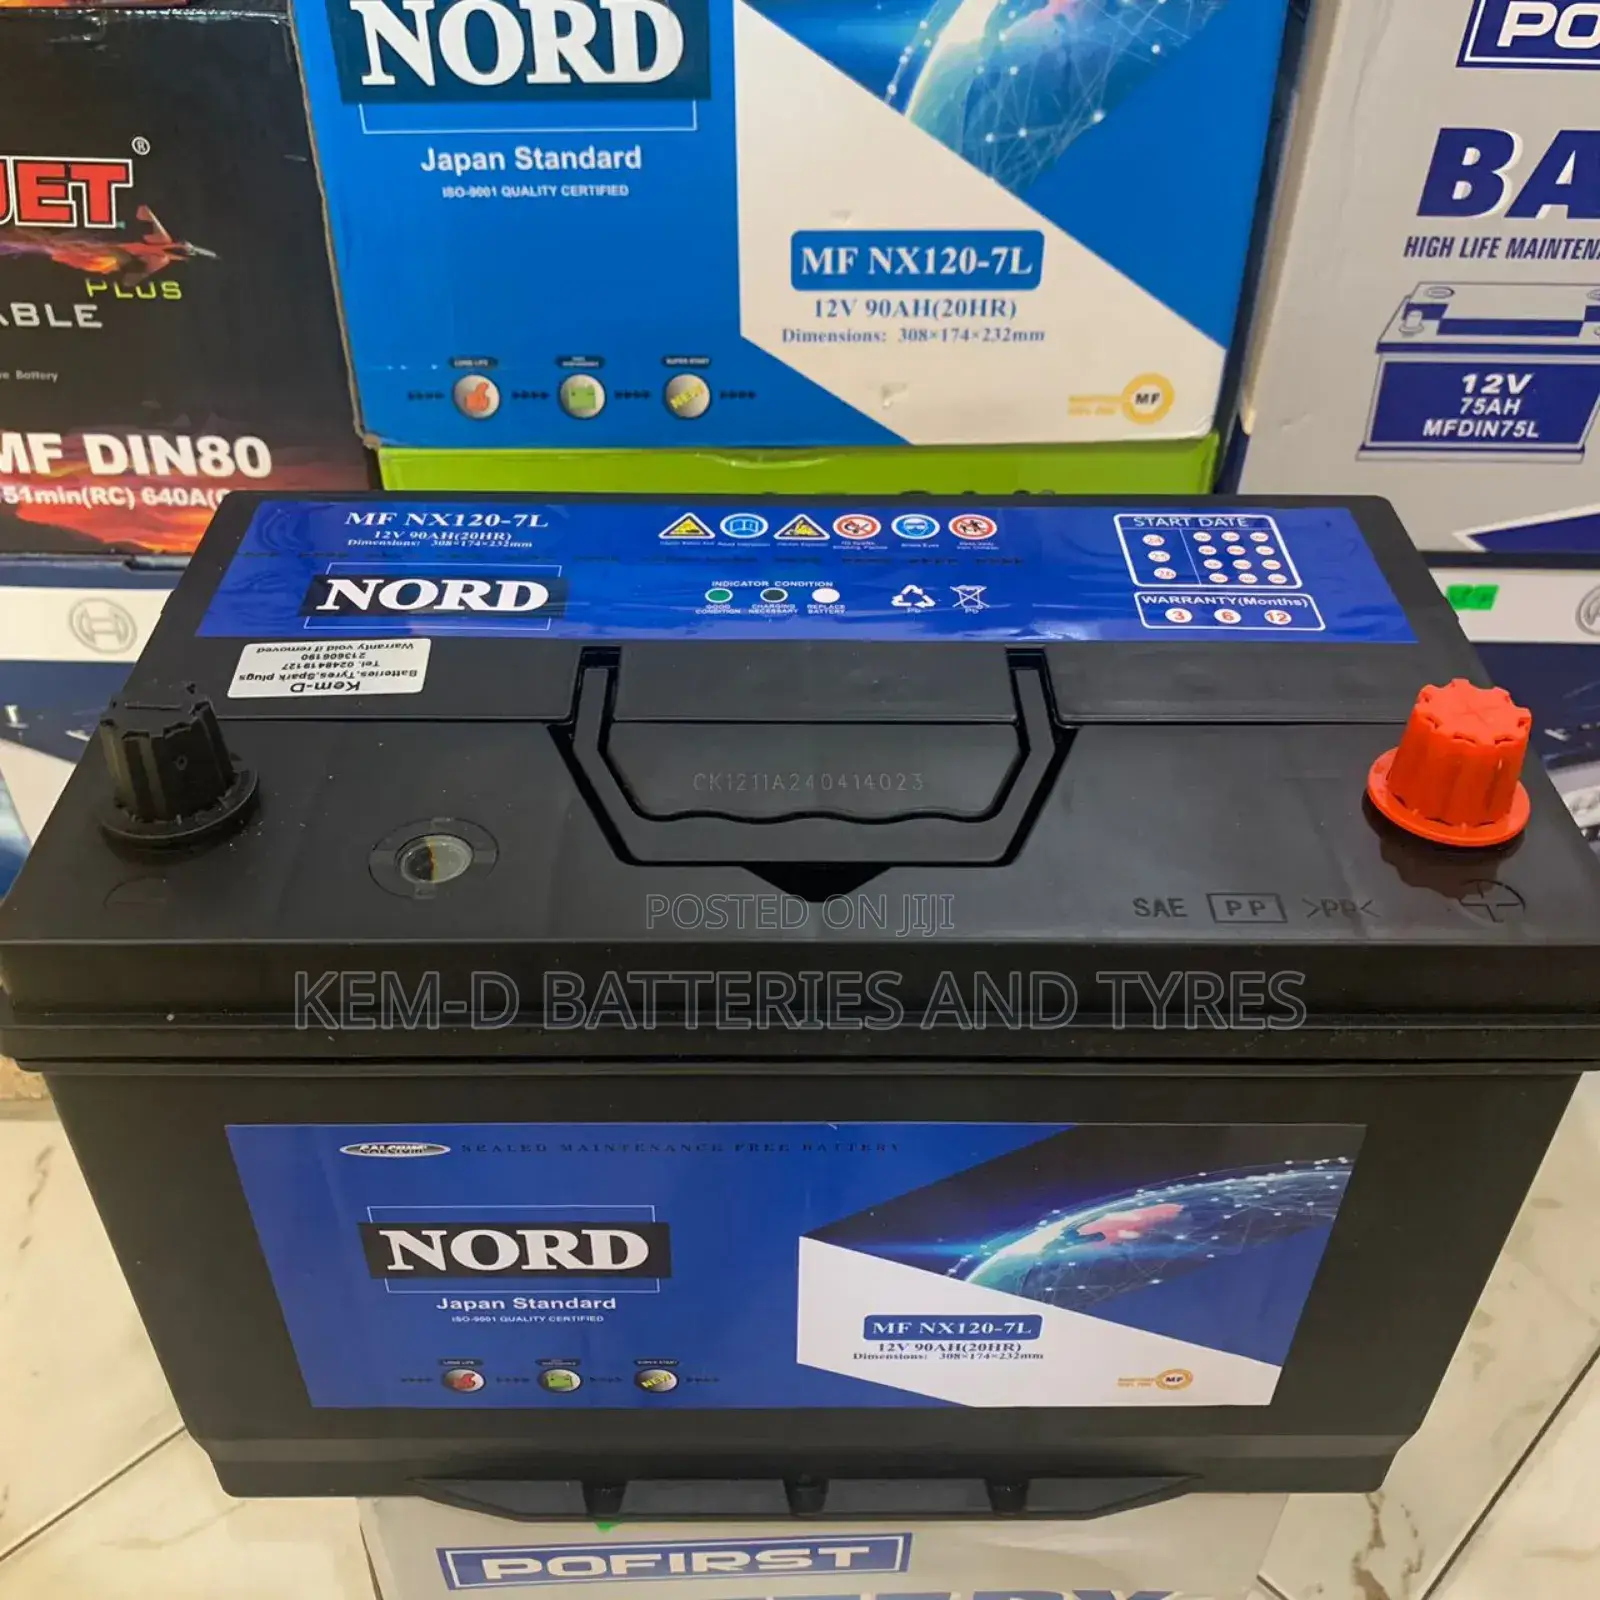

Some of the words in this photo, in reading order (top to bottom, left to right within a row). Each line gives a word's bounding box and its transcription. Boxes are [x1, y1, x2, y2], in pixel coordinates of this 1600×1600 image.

[1497, 1, 1600, 49] PO
[349, 0, 684, 87] NORD
[420, 148, 506, 176] Japan
[514, 145, 641, 172] Standard
[1417, 127, 1600, 220] BA
[442, 186, 497, 199] ISO-9001
[502, 185, 557, 198] QUALITY
[561, 184, 629, 197] CERTIFIED
[1403, 235, 1456, 258] HIGH
[1459, 236, 1503, 259] LIFE
[1505, 236, 1600, 260] MAINTEN
[800, 247, 859, 275] MF
[869, 245, 1033, 276] NX120-7L
[85, 278, 182, 300] PLUS
[815, 299, 857, 319] 12V
[865, 297, 1018, 322] 90AH(20HR)
[782, 327, 887, 344] Dimensions:
[15, 369, 59, 384] Battery
[1461, 372, 1535, 395] 12V
[1135, 392, 1160, 405] MF
[1460, 397, 1521, 417] 75AH
[1422, 418, 1540, 438] MFDIN75L
[0, 432, 64, 475] MF
[83, 434, 273, 478] DIN80
[345, 511, 398, 526] MF
[405, 513, 549, 528] NX120-7L
[1133, 517, 1190, 527] START
[1199, 517, 1249, 527] DATE
[347, 538, 421, 547] Dimensions:
[375, 530, 406, 540] 12V
[409, 530, 513, 541] 90AH(20HR)
[774, 580, 834, 588] CONDITION
[316, 578, 550, 612] NORD
[1141, 595, 1309, 609] WARRANTY(Months)
[1172, 610, 1186, 621] 3
[1222, 611, 1234, 622] 6
[1266, 611, 1289, 623] 12
[255, 646, 313, 654] removed
[312, 645, 324, 654] if
[325, 644, 355, 653] void
[358, 642, 415, 652] Warranty
[359, 660, 381, 669] Tel.
[238, 673, 276, 682] plugs
[289, 680, 361, 693] Kem-D
[1133, 898, 1188, 918] SAE
[1224, 900, 1267, 916] PP
[460, 1143, 548, 1152] SEALED
[560, 1143, 725, 1152] MAINTENANCE
[734, 1143, 791, 1152] FREE
[801, 1143, 899, 1152] BATTERY
[379, 1229, 650, 1271] NORD
[436, 1297, 506, 1313] Japan
[513, 1297, 617, 1311] Standard
[452, 1315, 497, 1323] ISO-9001
[500, 1315, 546, 1323] QUALITY
[548, 1315, 604, 1323] CERTIFIED
[872, 1321, 910, 1335] MF
[919, 1321, 1032, 1335] NX120-7L
[877, 1341, 909, 1353] 12V
[914, 1341, 1022, 1354] 90AH(20HR)
[853, 1352, 928, 1360] Dimensions:
[482, 1546, 871, 1581] POFIRST
